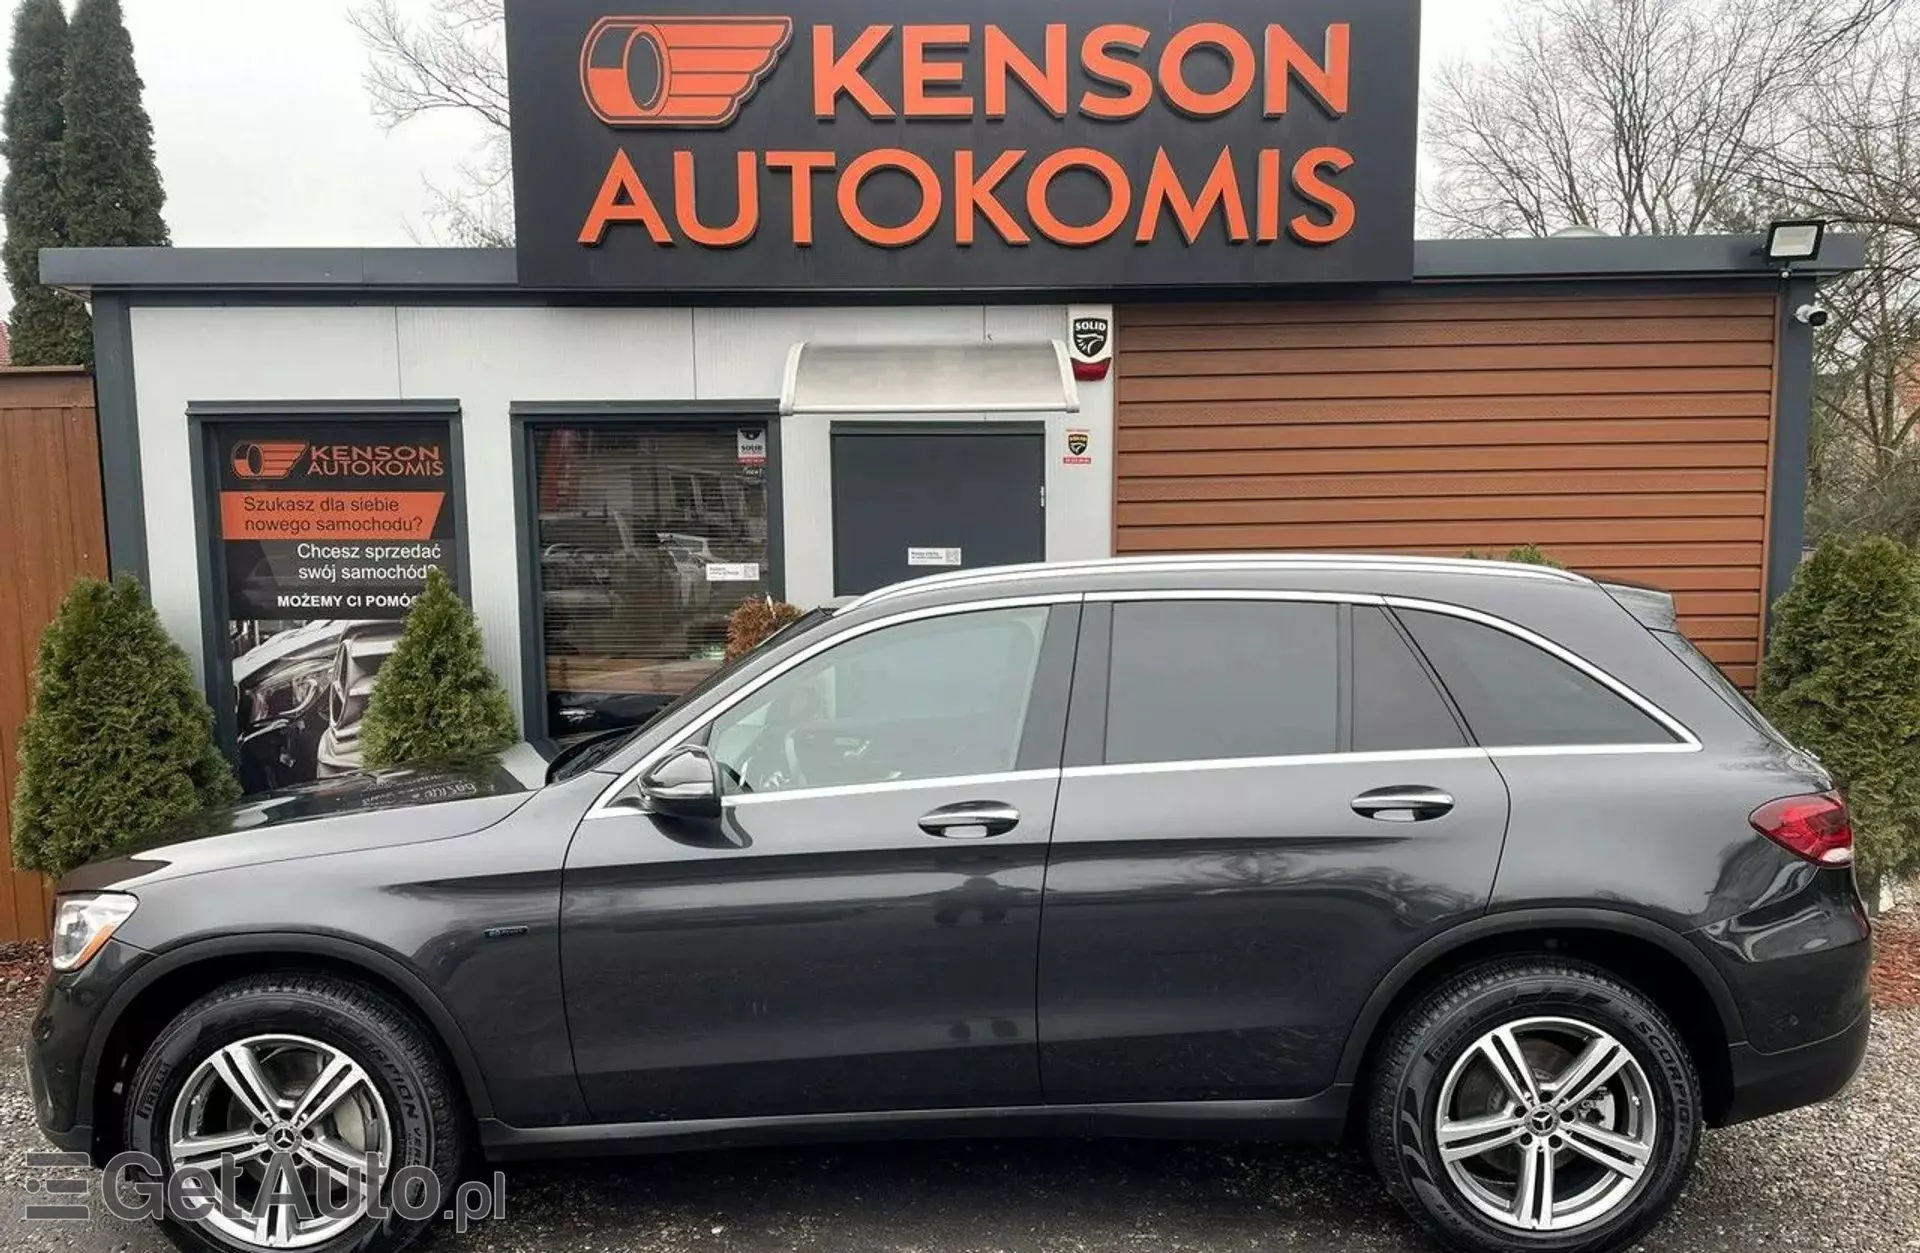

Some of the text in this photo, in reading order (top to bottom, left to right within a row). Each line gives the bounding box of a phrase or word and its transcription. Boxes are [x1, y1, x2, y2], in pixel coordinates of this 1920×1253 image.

[812, 22, 1350, 119] KENSON
[577, 145, 1357, 248] AUTOKOMIS
[1075, 320, 1107, 332] SOLID
[310, 445, 440, 460] KENSON
[307, 460, 445, 476] AUTOKOMIS
[244, 496, 399, 511] Szukasz dla siebie
[244, 516, 423, 535] nowego samochodu?
[297, 543, 441, 562] Chcesz sprzedać
[299, 565, 336, 583] swój
[277, 594, 343, 607] MOŻEMY
[347, 595, 361, 607] CI
